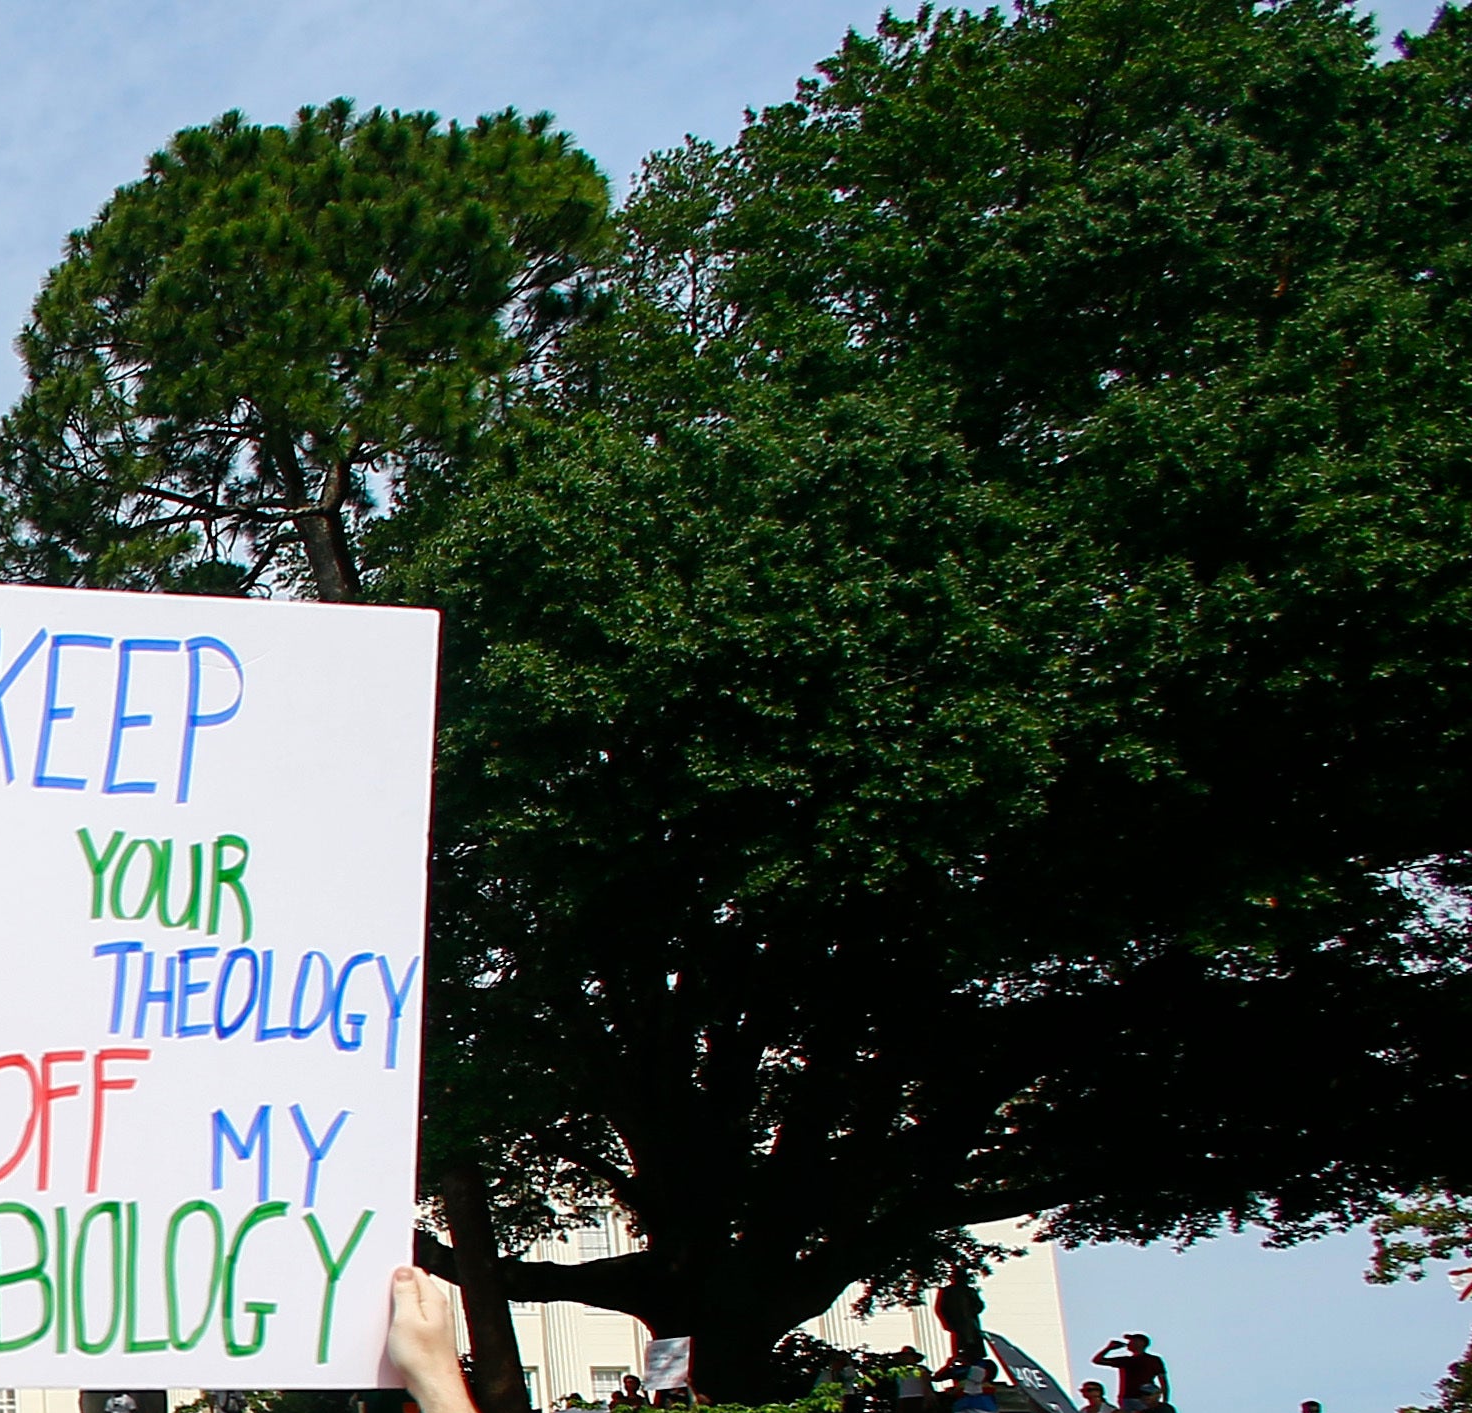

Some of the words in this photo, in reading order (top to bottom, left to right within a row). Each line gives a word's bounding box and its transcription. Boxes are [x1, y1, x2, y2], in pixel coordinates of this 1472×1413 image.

[75, 827, 255, 942] YOUR
[93, 941, 420, 1070] THEOLOGY
[211, 1102, 351, 1208] MY
